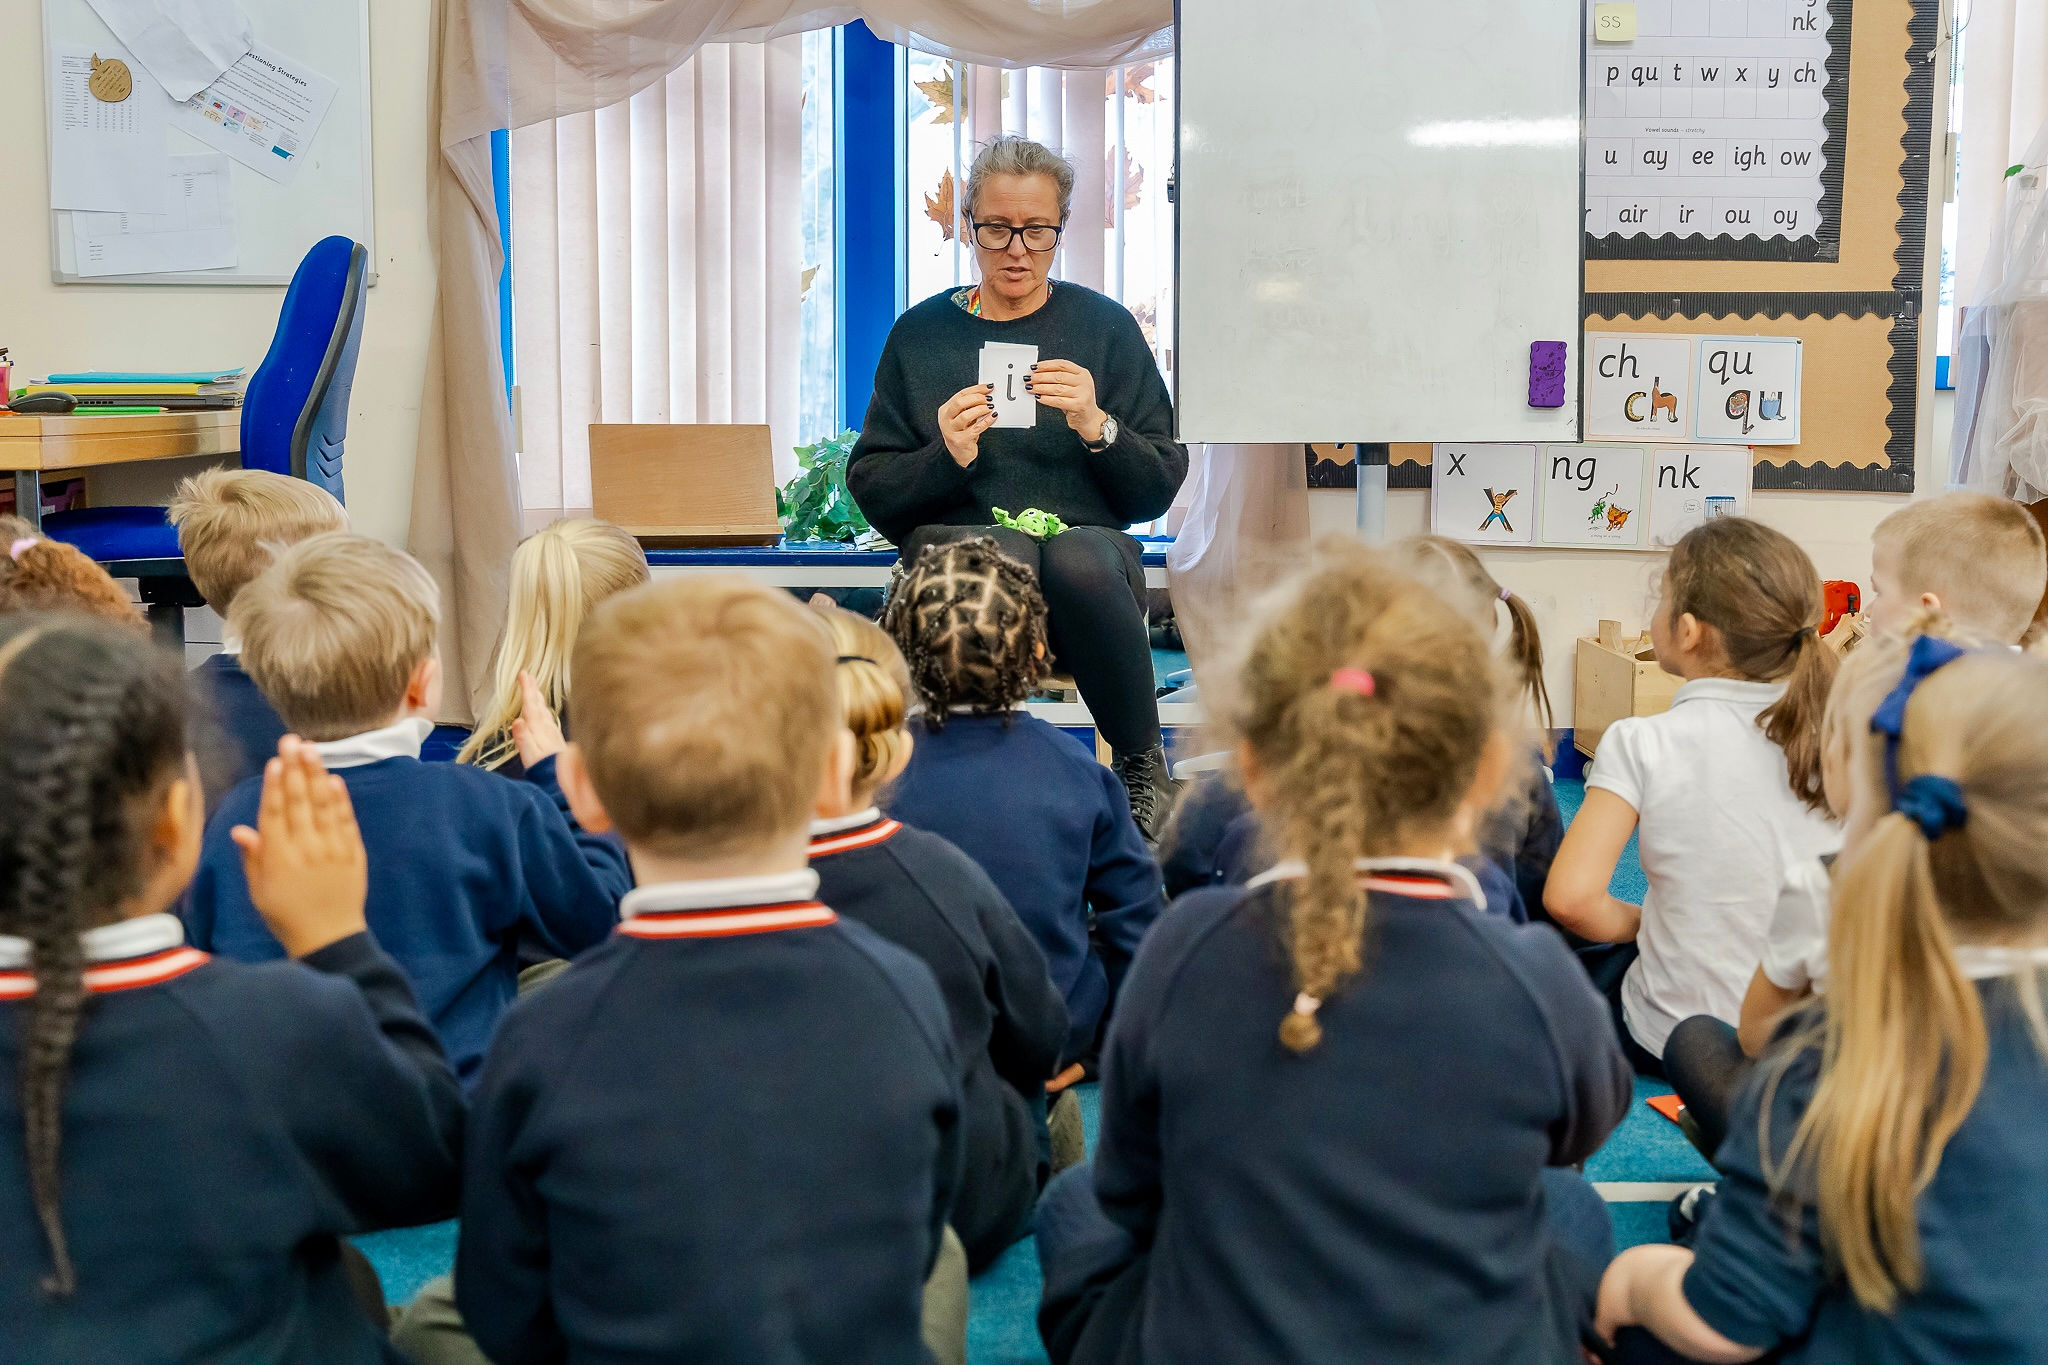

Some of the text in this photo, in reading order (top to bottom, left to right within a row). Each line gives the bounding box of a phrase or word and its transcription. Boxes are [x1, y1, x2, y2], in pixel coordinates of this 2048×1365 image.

[1792, 10, 1818, 31] nk
[277, 66, 308, 87] Strategies
[1606, 61, 1817, 88] p qu t w x y ch
[1604, 144, 1812, 171] u ay ee igh ow
[1618, 204, 1648, 224] air
[1679, 204, 1695, 224] ir
[1724, 209, 1751, 224] ou
[1773, 209, 1798, 230] oy
[1598, 342, 1640, 379] ch
[1708, 350, 1754, 386] qu
[1006, 363, 1017, 402] i
[1446, 452, 1467, 477] x
[1551, 456, 1597, 492] ng
[1658, 454, 1701, 490] nk
